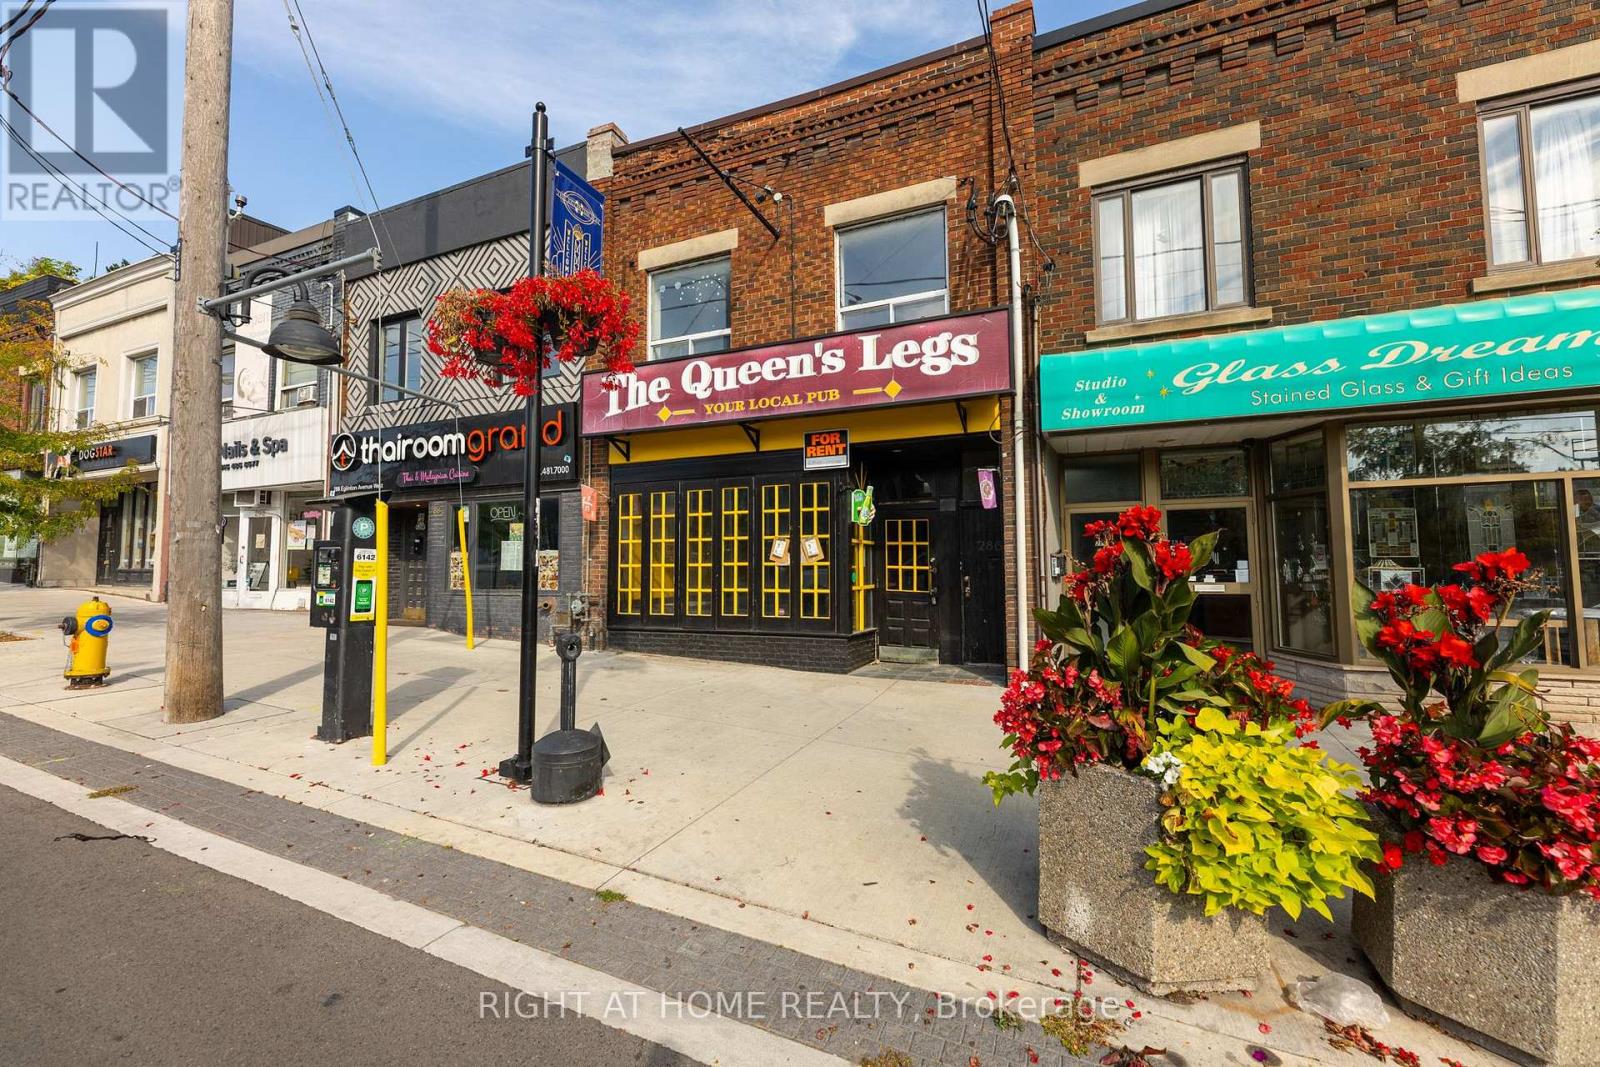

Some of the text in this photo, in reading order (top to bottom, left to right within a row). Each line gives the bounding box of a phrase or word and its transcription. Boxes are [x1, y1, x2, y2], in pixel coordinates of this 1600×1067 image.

[601, 331, 980, 417] The Queen's Legs
[1173, 359, 1347, 396] Glass
[1074, 376, 1127, 392] Studio
[1251, 364, 1574, 406] Stained Glass & Gift Ideas
[704, 389, 840, 415] YOUR LOCAL PUB
[1094, 392, 1107, 405] &
[1061, 403, 1145, 420] Showroom
[250, 438, 260, 456] &
[262, 436, 288, 458] Spa
[811, 432, 840, 445] FOR
[806, 443, 846, 457] RENT
[490, 506, 516, 519] OPEN
